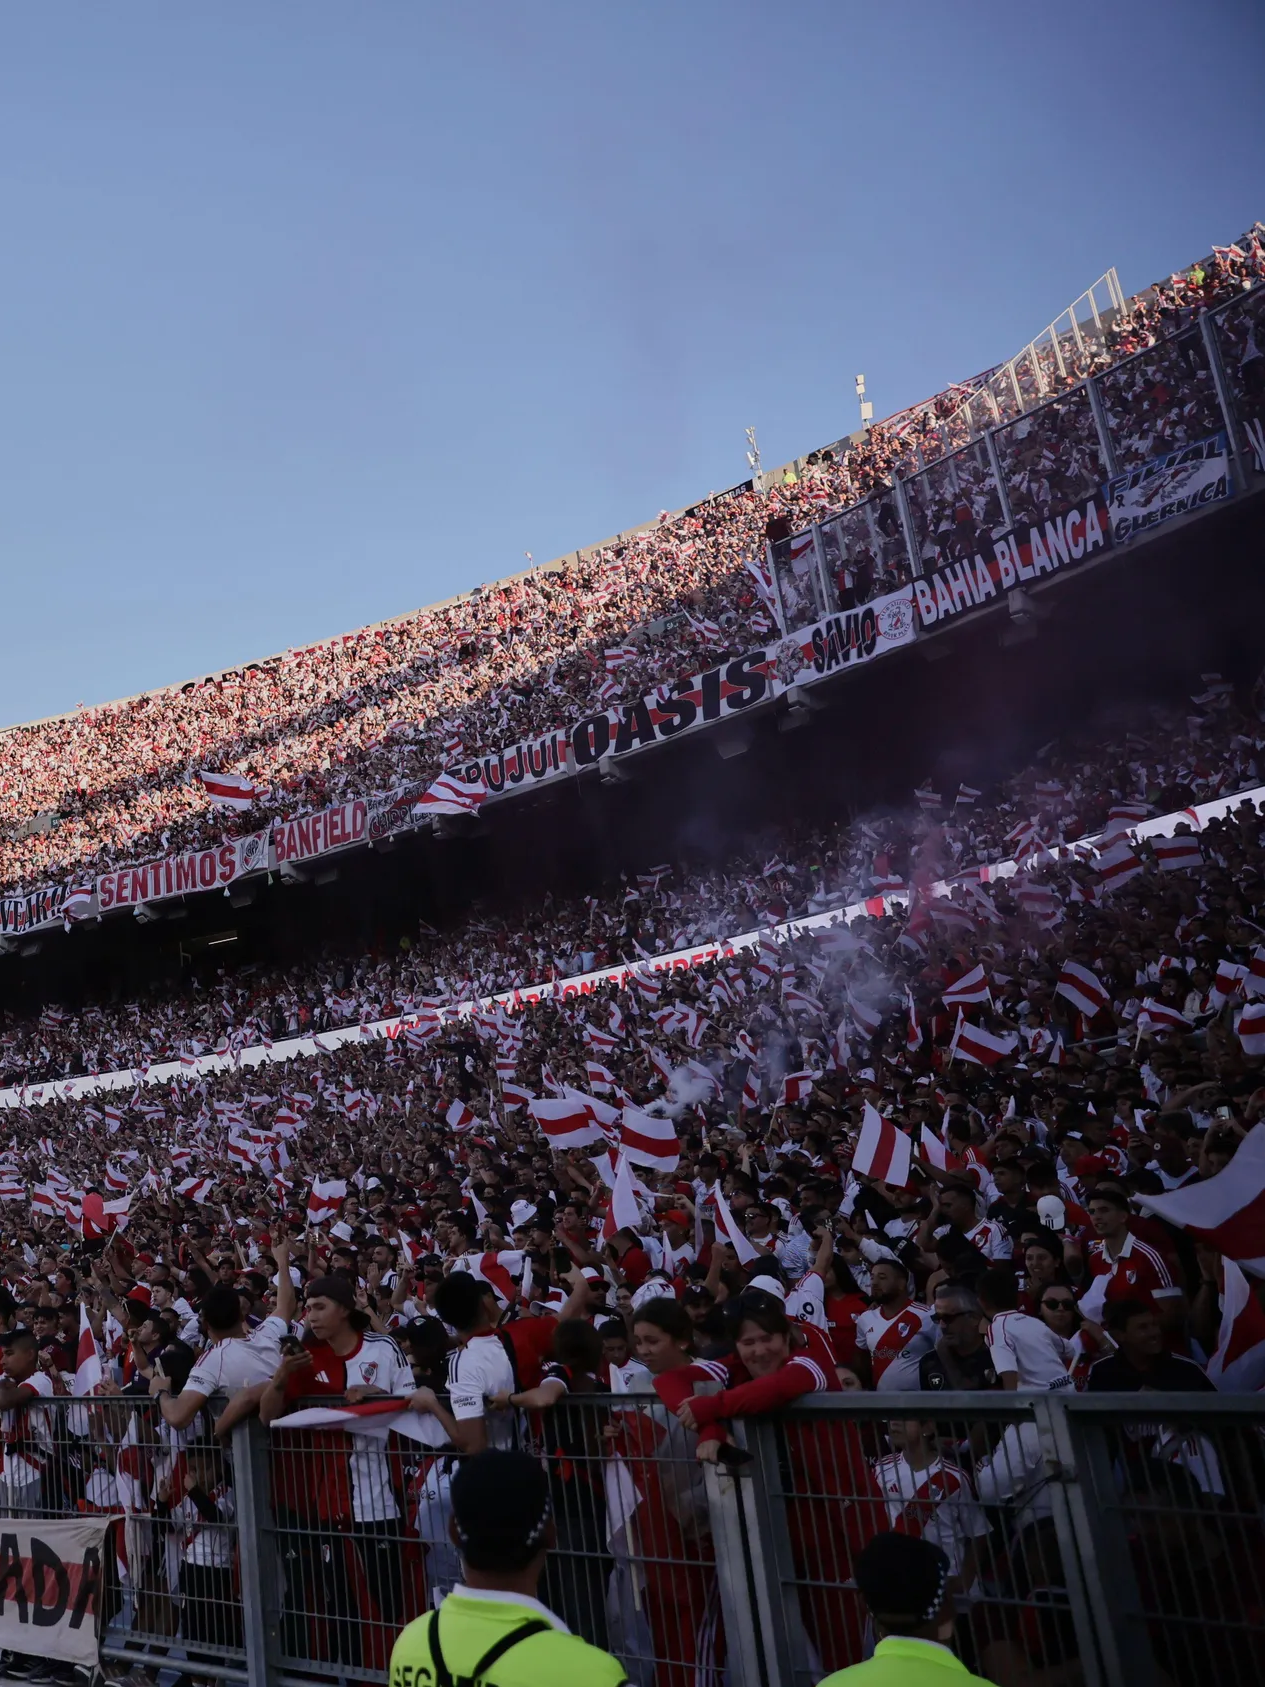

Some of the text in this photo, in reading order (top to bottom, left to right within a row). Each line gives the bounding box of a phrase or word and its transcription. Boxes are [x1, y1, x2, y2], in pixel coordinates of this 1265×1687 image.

[1108, 436, 1225, 508] FILIAL
[1115, 473, 1229, 542] GUERNICA
[914, 506, 1104, 627] BAHIA BLANCA
[811, 607, 876, 674] SAVIO
[571, 650, 769, 766] OASIS
[274, 800, 366, 865] BANFIELD
[100, 845, 236, 908] SENTIMOS
